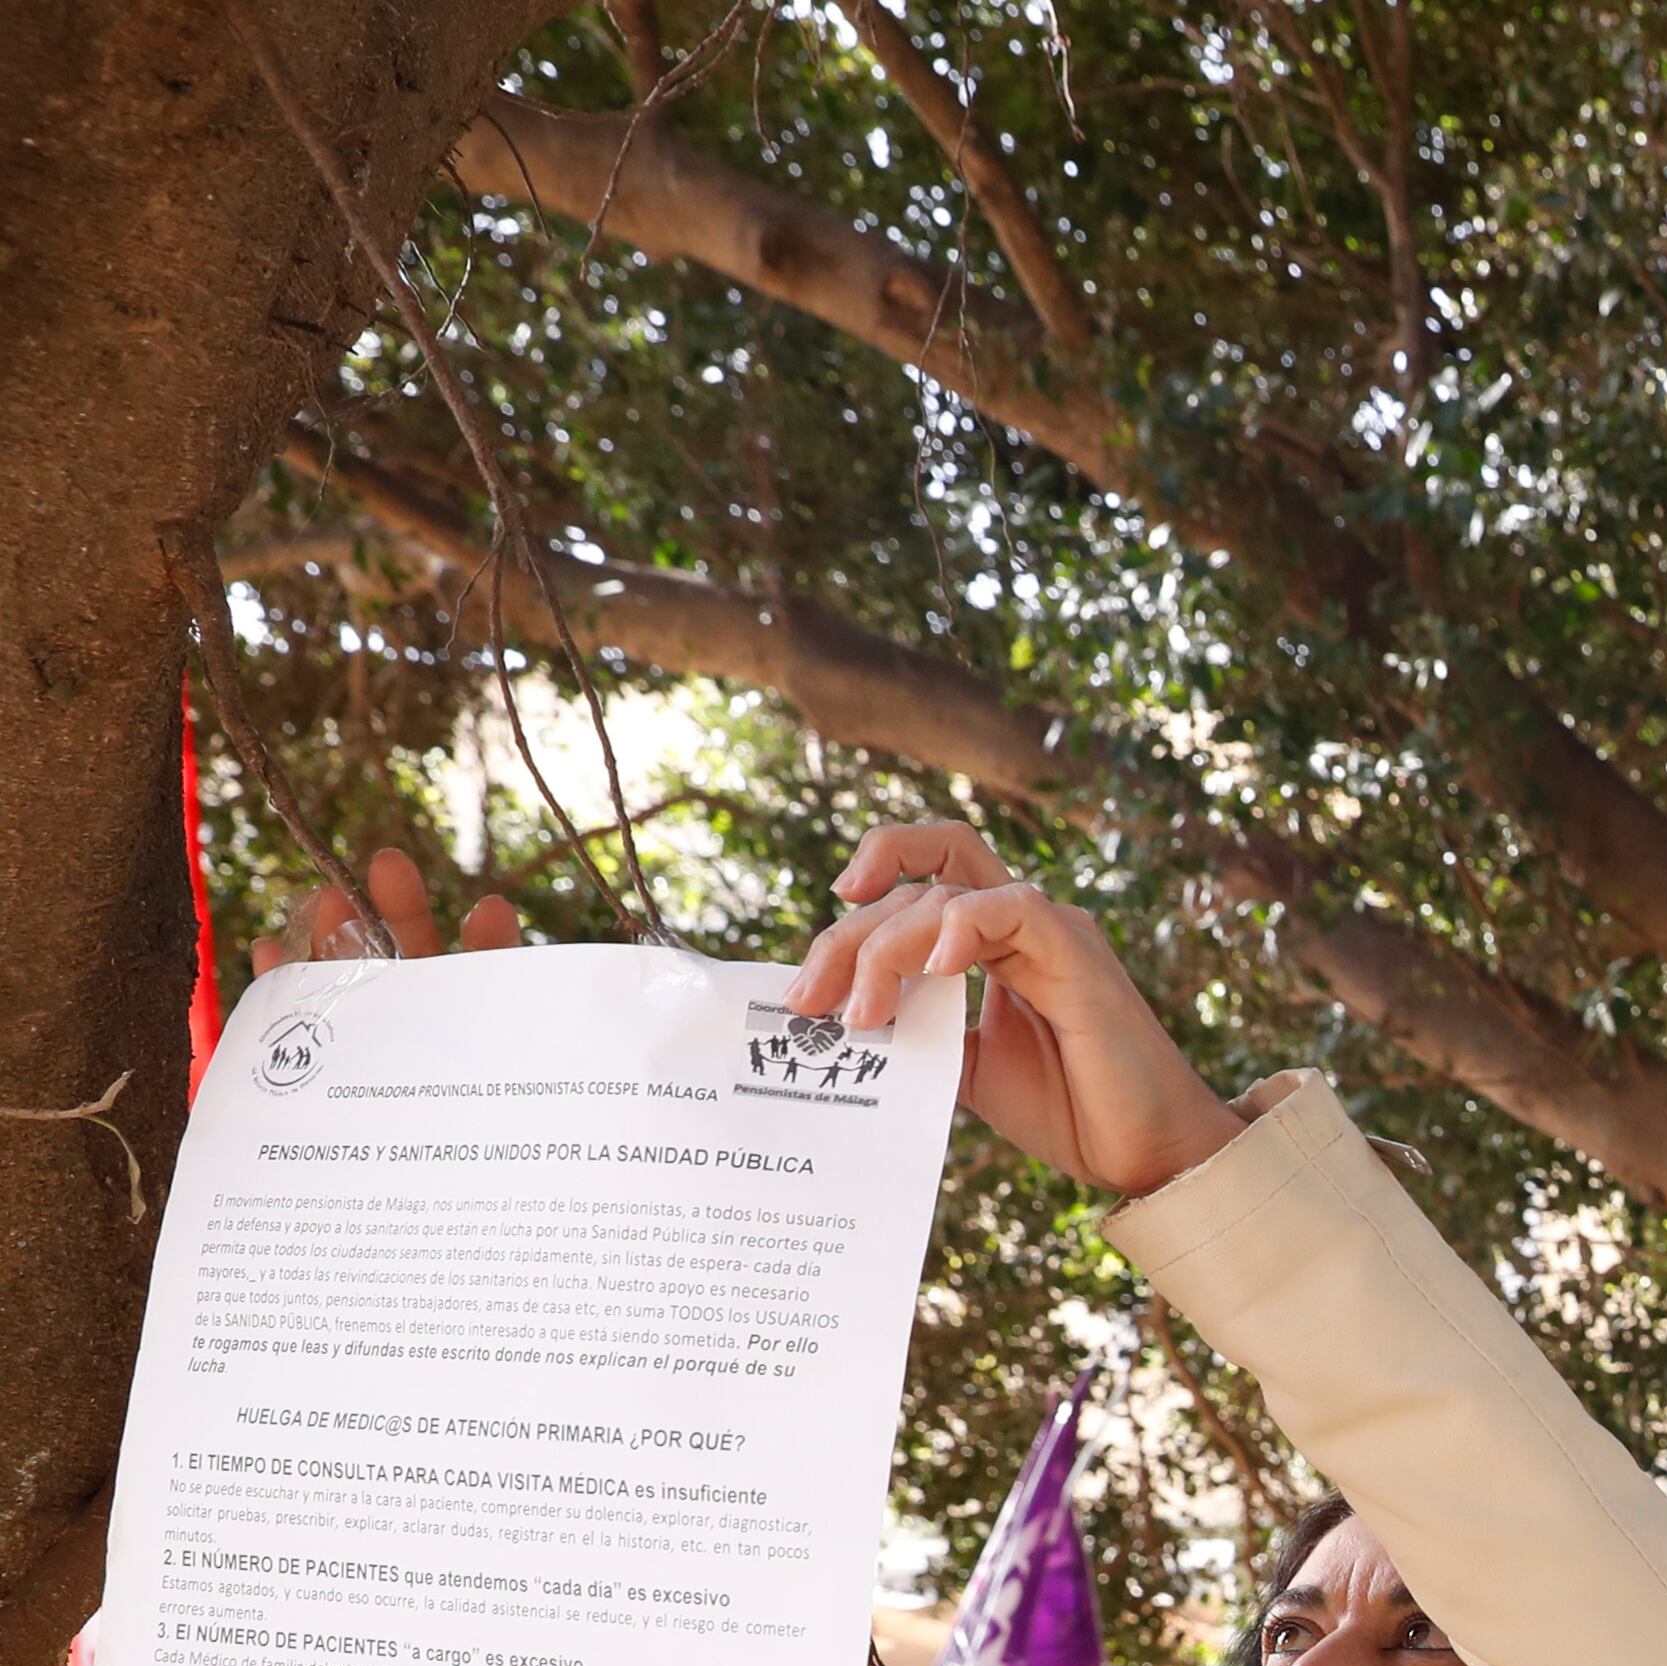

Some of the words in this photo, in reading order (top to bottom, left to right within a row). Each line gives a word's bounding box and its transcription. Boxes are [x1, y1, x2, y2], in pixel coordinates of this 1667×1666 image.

[327, 1086, 416, 1099] COORDINADORA
[418, 1084, 484, 1097] PROVINCIAL
[487, 1083, 501, 1096] DE
[505, 1081, 584, 1096] PENSIONISTAS
[587, 1081, 639, 1096] COESPE
[647, 1081, 718, 1102] MÁLAGA
[258, 1144, 371, 1161] PENSIONISTAS
[376, 1145, 387, 1161] Y
[389, 1144, 479, 1161] SANITARIOS
[484, 1144, 542, 1161] UNIDOS
[546, 1143, 582, 1160] POR
[587, 1144, 611, 1161] LA
[617, 1145, 709, 1166] SANIDAD
[715, 1147, 814, 1175] PÚBLICA
[236, 1407, 302, 1426] HUELGA
[307, 1411, 330, 1428] DE
[333, 1412, 412, 1436] MEDIC@S
[417, 1417, 440, 1434] DE
[445, 1417, 531, 1439] ATENCIÓN
[537, 1423, 624, 1444] PRIMARIA
[630, 1429, 682, 1450] ¿POR
[689, 1429, 746, 1452] QUÉ?
[172, 1452, 183, 1469] 1.
[189, 1453, 203, 1470] El
[207, 1454, 266, 1474] TIEMPO
[271, 1458, 293, 1475] DE
[297, 1460, 388, 1482] CONSULTA
[393, 1466, 439, 1485] PARA
[444, 1469, 493, 1488] CADA
[498, 1472, 554, 1492] VISITA
[559, 1472, 630, 1497] MÉDICA
[635, 1485, 655, 1499] es
[662, 1482, 767, 1505] insuficiente
[163, 1549, 176, 1566] 2.
[182, 1550, 196, 1567] El
[202, 1548, 273, 1573] NÚMERO
[278, 1557, 300, 1575] DE
[306, 1559, 399, 1582] PACIENTES
[405, 1571, 433, 1588] que
[439, 1571, 528, 1592] atendemos
[534, 1576, 582, 1596] “cada
[588, 1581, 621, 1598] día”
[627, 1587, 647, 1601] es
[652, 1588, 730, 1607] excesivo
[157, 1622, 170, 1639] 3.
[176, 1623, 191, 1640] El
[196, 1621, 270, 1647] NÚMERO
[275, 1631, 297, 1649] DE
[303, 1634, 398, 1658] PACIENTES
[404, 1643, 421, 1659] “a
[426, 1648, 479, 1666] cargo”
[485, 1653, 504, 1666] es
